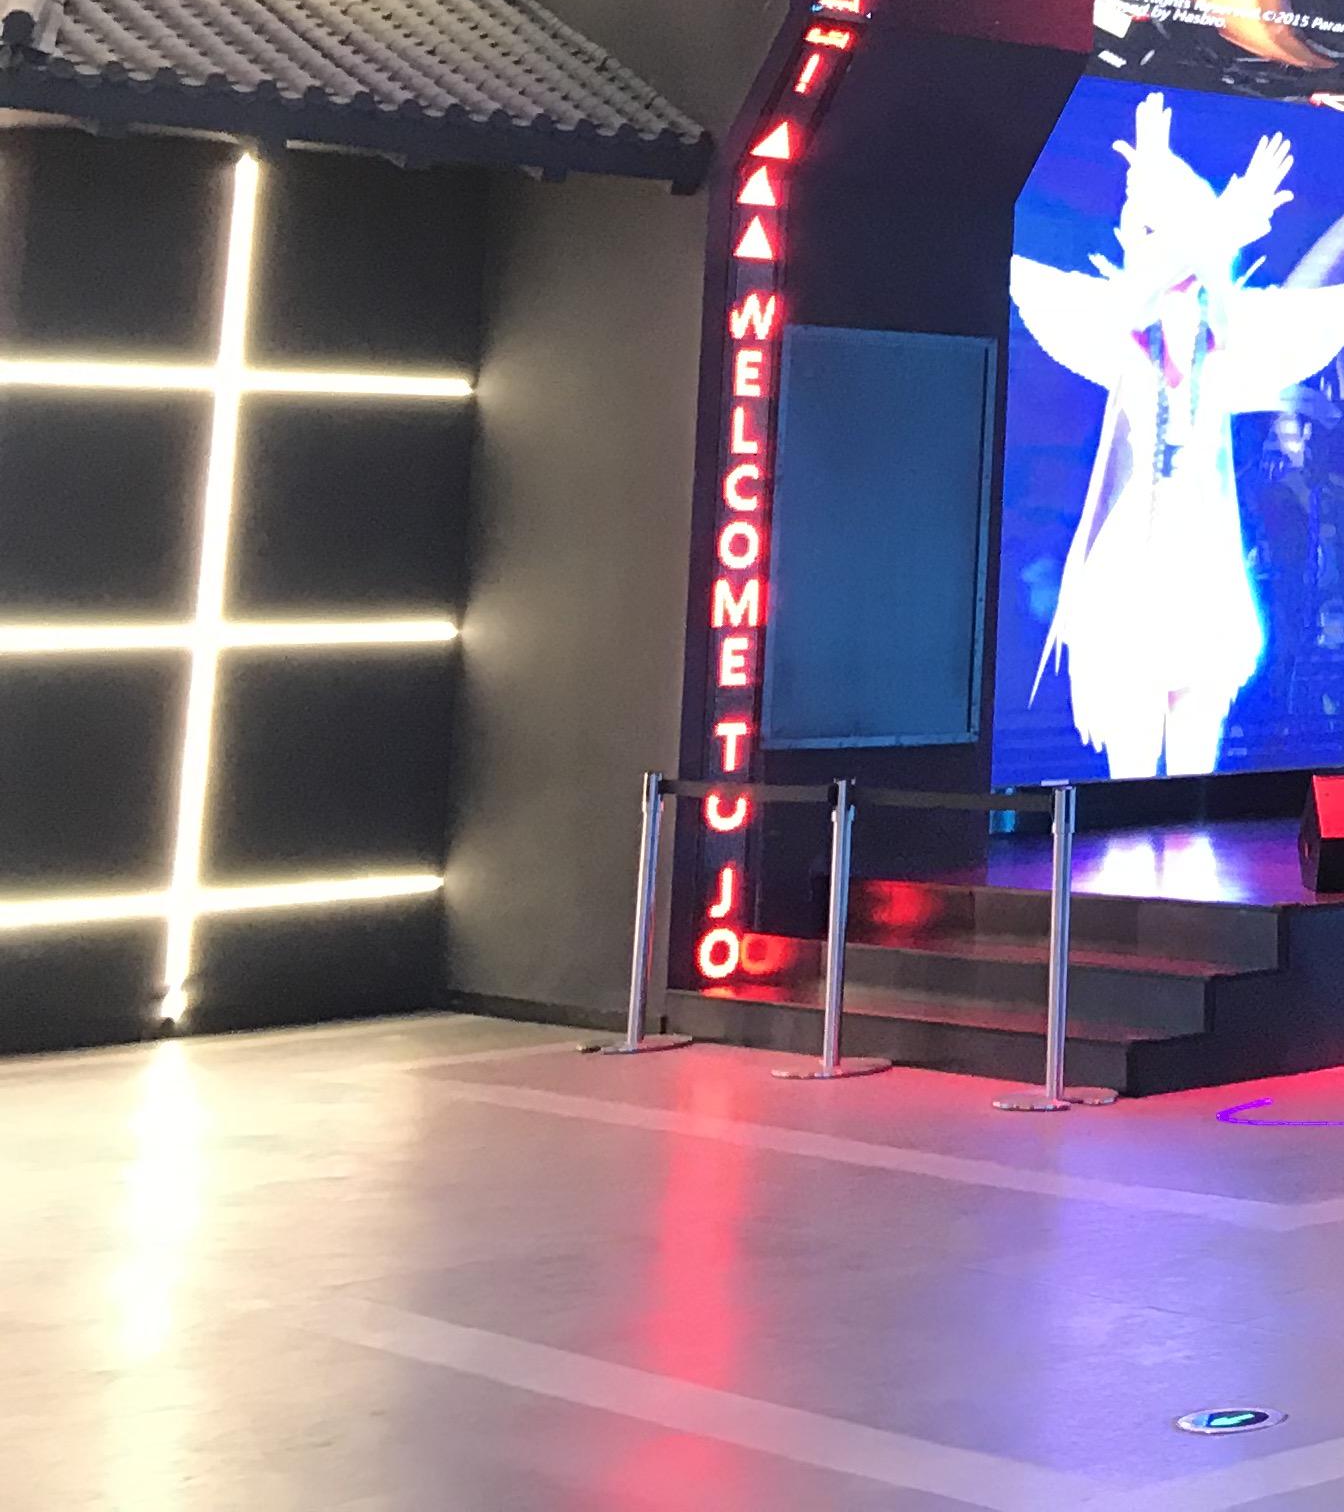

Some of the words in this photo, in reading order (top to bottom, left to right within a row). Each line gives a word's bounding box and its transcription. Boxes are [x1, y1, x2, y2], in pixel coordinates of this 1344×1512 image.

[1150, 4, 1172, 21] by
[712, 292, 776, 688] WELCOME
[706, 722, 748, 832] TO
[699, 866, 741, 980] JO
